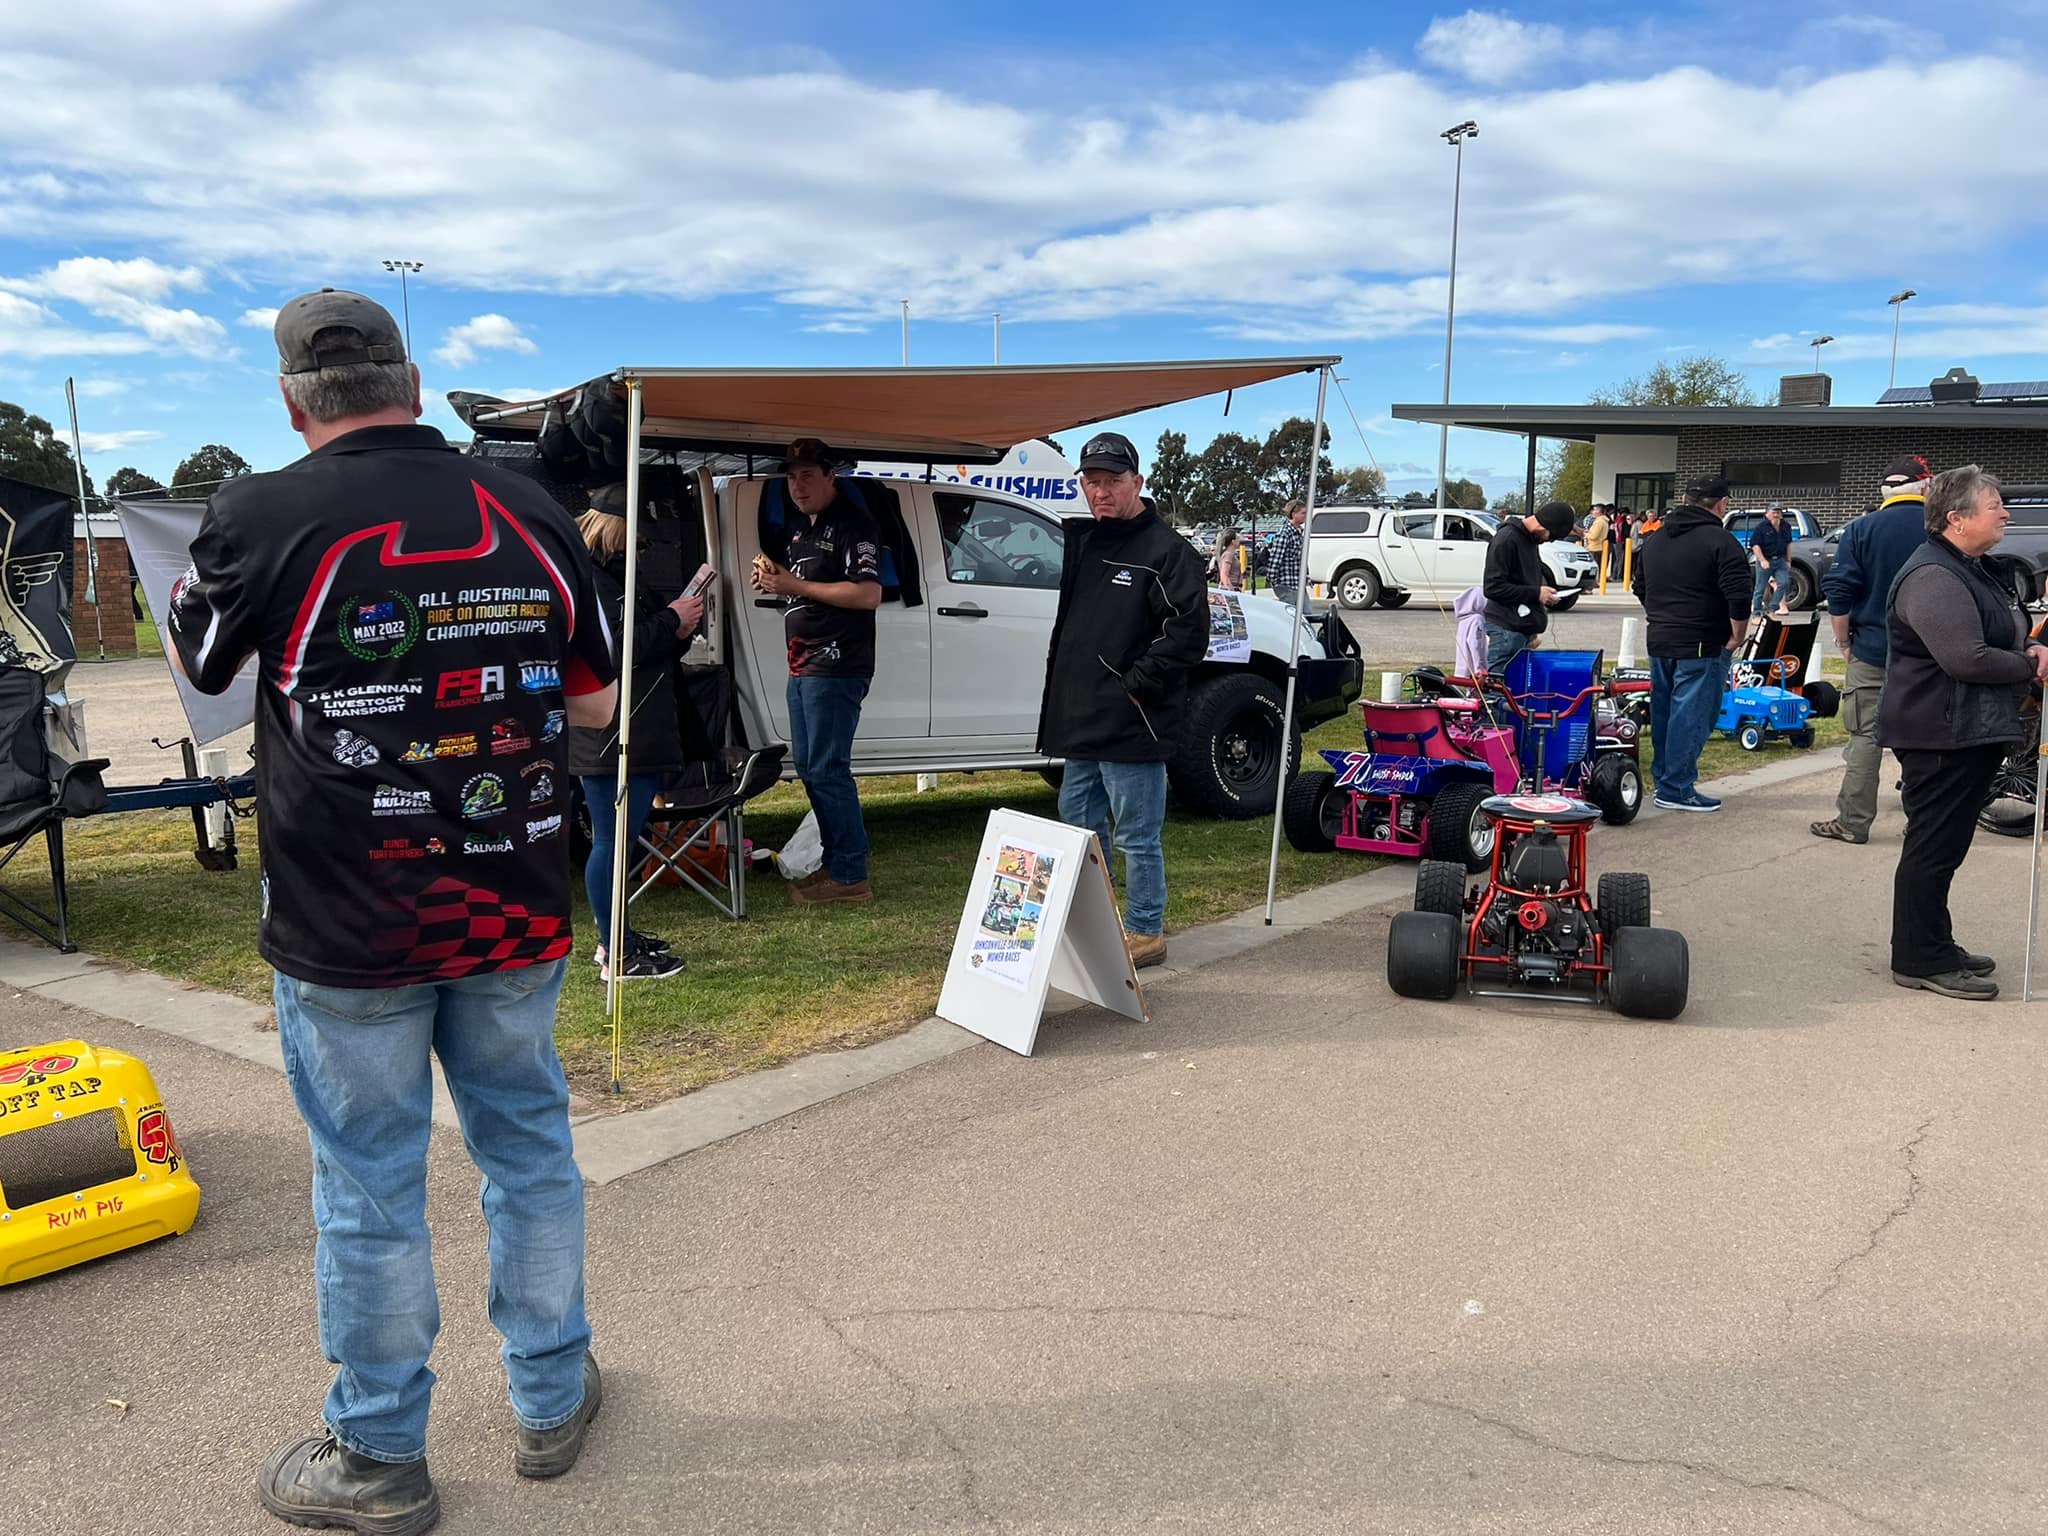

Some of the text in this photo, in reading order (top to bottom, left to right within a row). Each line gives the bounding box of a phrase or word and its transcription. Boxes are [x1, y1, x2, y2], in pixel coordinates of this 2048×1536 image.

[418, 587, 550, 607] ALL AUSTRALIAN
[427, 608, 453, 624] RIDE
[457, 606, 472, 621] ON
[475, 604, 518, 619] MOWER
[353, 620, 405, 640] MAY 2022
[426, 620, 546, 641] CHAMPIONSHIPS
[436, 665, 504, 700] FSA
[308, 683, 422, 703] J & K GLENNAN
[324, 695, 406, 709] LIVESTOCK
[1734, 698, 1756, 706] POLICE
[323, 703, 406, 718] TRANSPORT
[48, 1077, 102, 1101] TAP
[47, 1196, 124, 1229] RUM PIG
